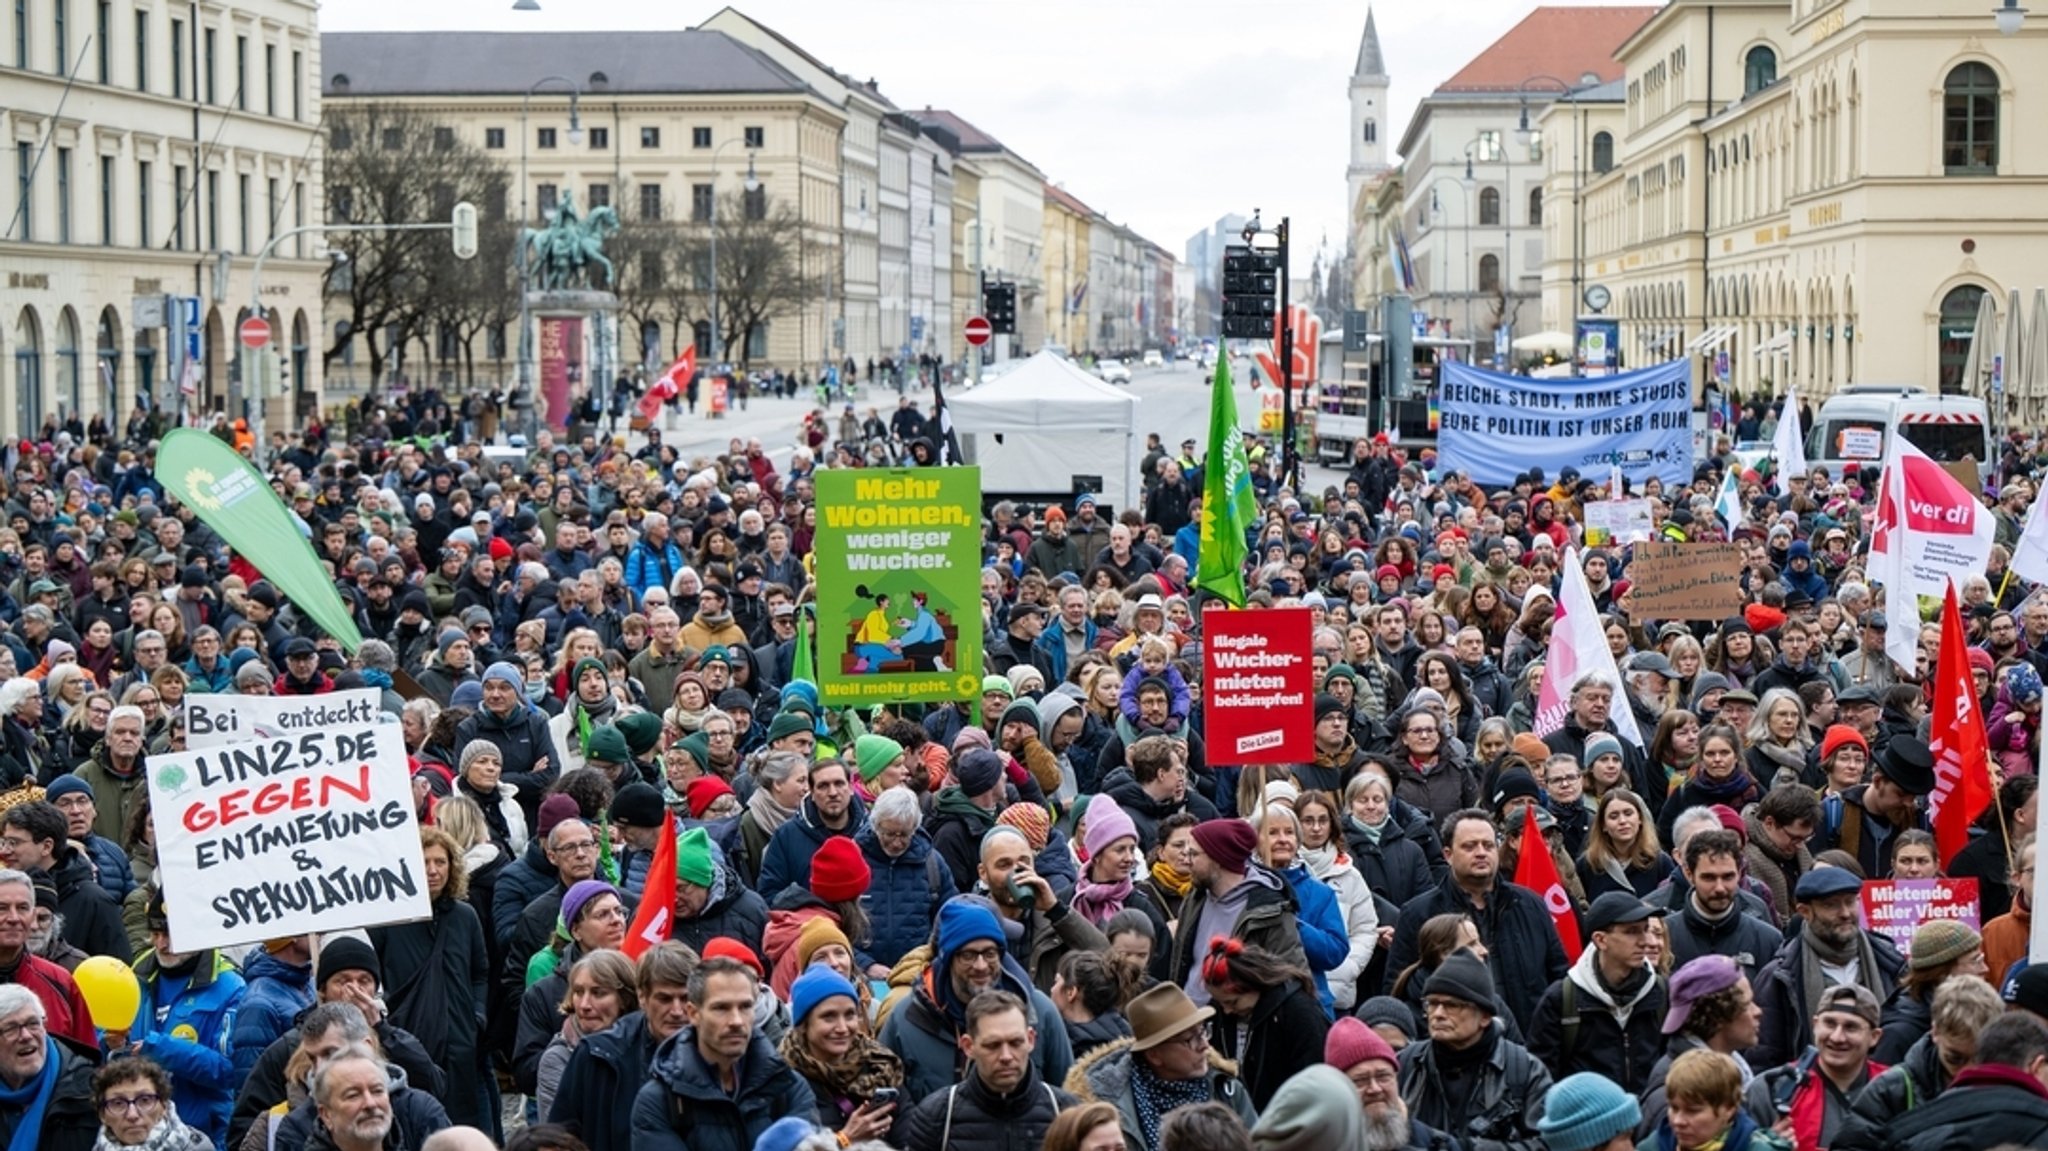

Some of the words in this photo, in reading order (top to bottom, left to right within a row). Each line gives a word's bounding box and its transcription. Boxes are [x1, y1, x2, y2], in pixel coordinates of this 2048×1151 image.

[1444, 383, 1501, 405] REICHE
[1575, 390, 1623, 409] ARME
[1630, 381, 1687, 405] STUDIS
[1441, 411, 1480, 432] EURE
[1487, 416, 1551, 437] POLITIK
[1558, 419, 1585, 437] IST
[1591, 414, 1644, 435] UNSER
[1650, 410, 1688, 429] RUIN
[855, 477, 940, 500] Mehr
[825, 504, 971, 528] Wohnen,
[1910, 498, 1970, 525] ver.di
[846, 529, 951, 550] weniger
[846, 552, 952, 570] Wucher.
[1213, 634, 1268, 650] Illegale
[1213, 651, 1302, 668] Wucher-
[825, 683, 860, 695] Weil
[863, 681, 905, 695] mehr
[908, 680, 951, 695] geht.
[1214, 673, 1285, 690] mieten
[1214, 693, 1304, 709] bekämpfen!
[189, 705, 239, 734] Bei
[1240, 738, 1256, 750] Die
[1256, 735, 1280, 747] Linke
[195, 729, 378, 787] LIN25.DE
[183, 764, 371, 832] GEGEN
[195, 800, 408, 870] ENTMIETUNG
[291, 848, 322, 871] &
[212, 858, 418, 930] SPEKULATION
[1871, 885, 1953, 902] Mietende
[1871, 904, 1913, 919] aller
[1915, 902, 1975, 918] Viertel
